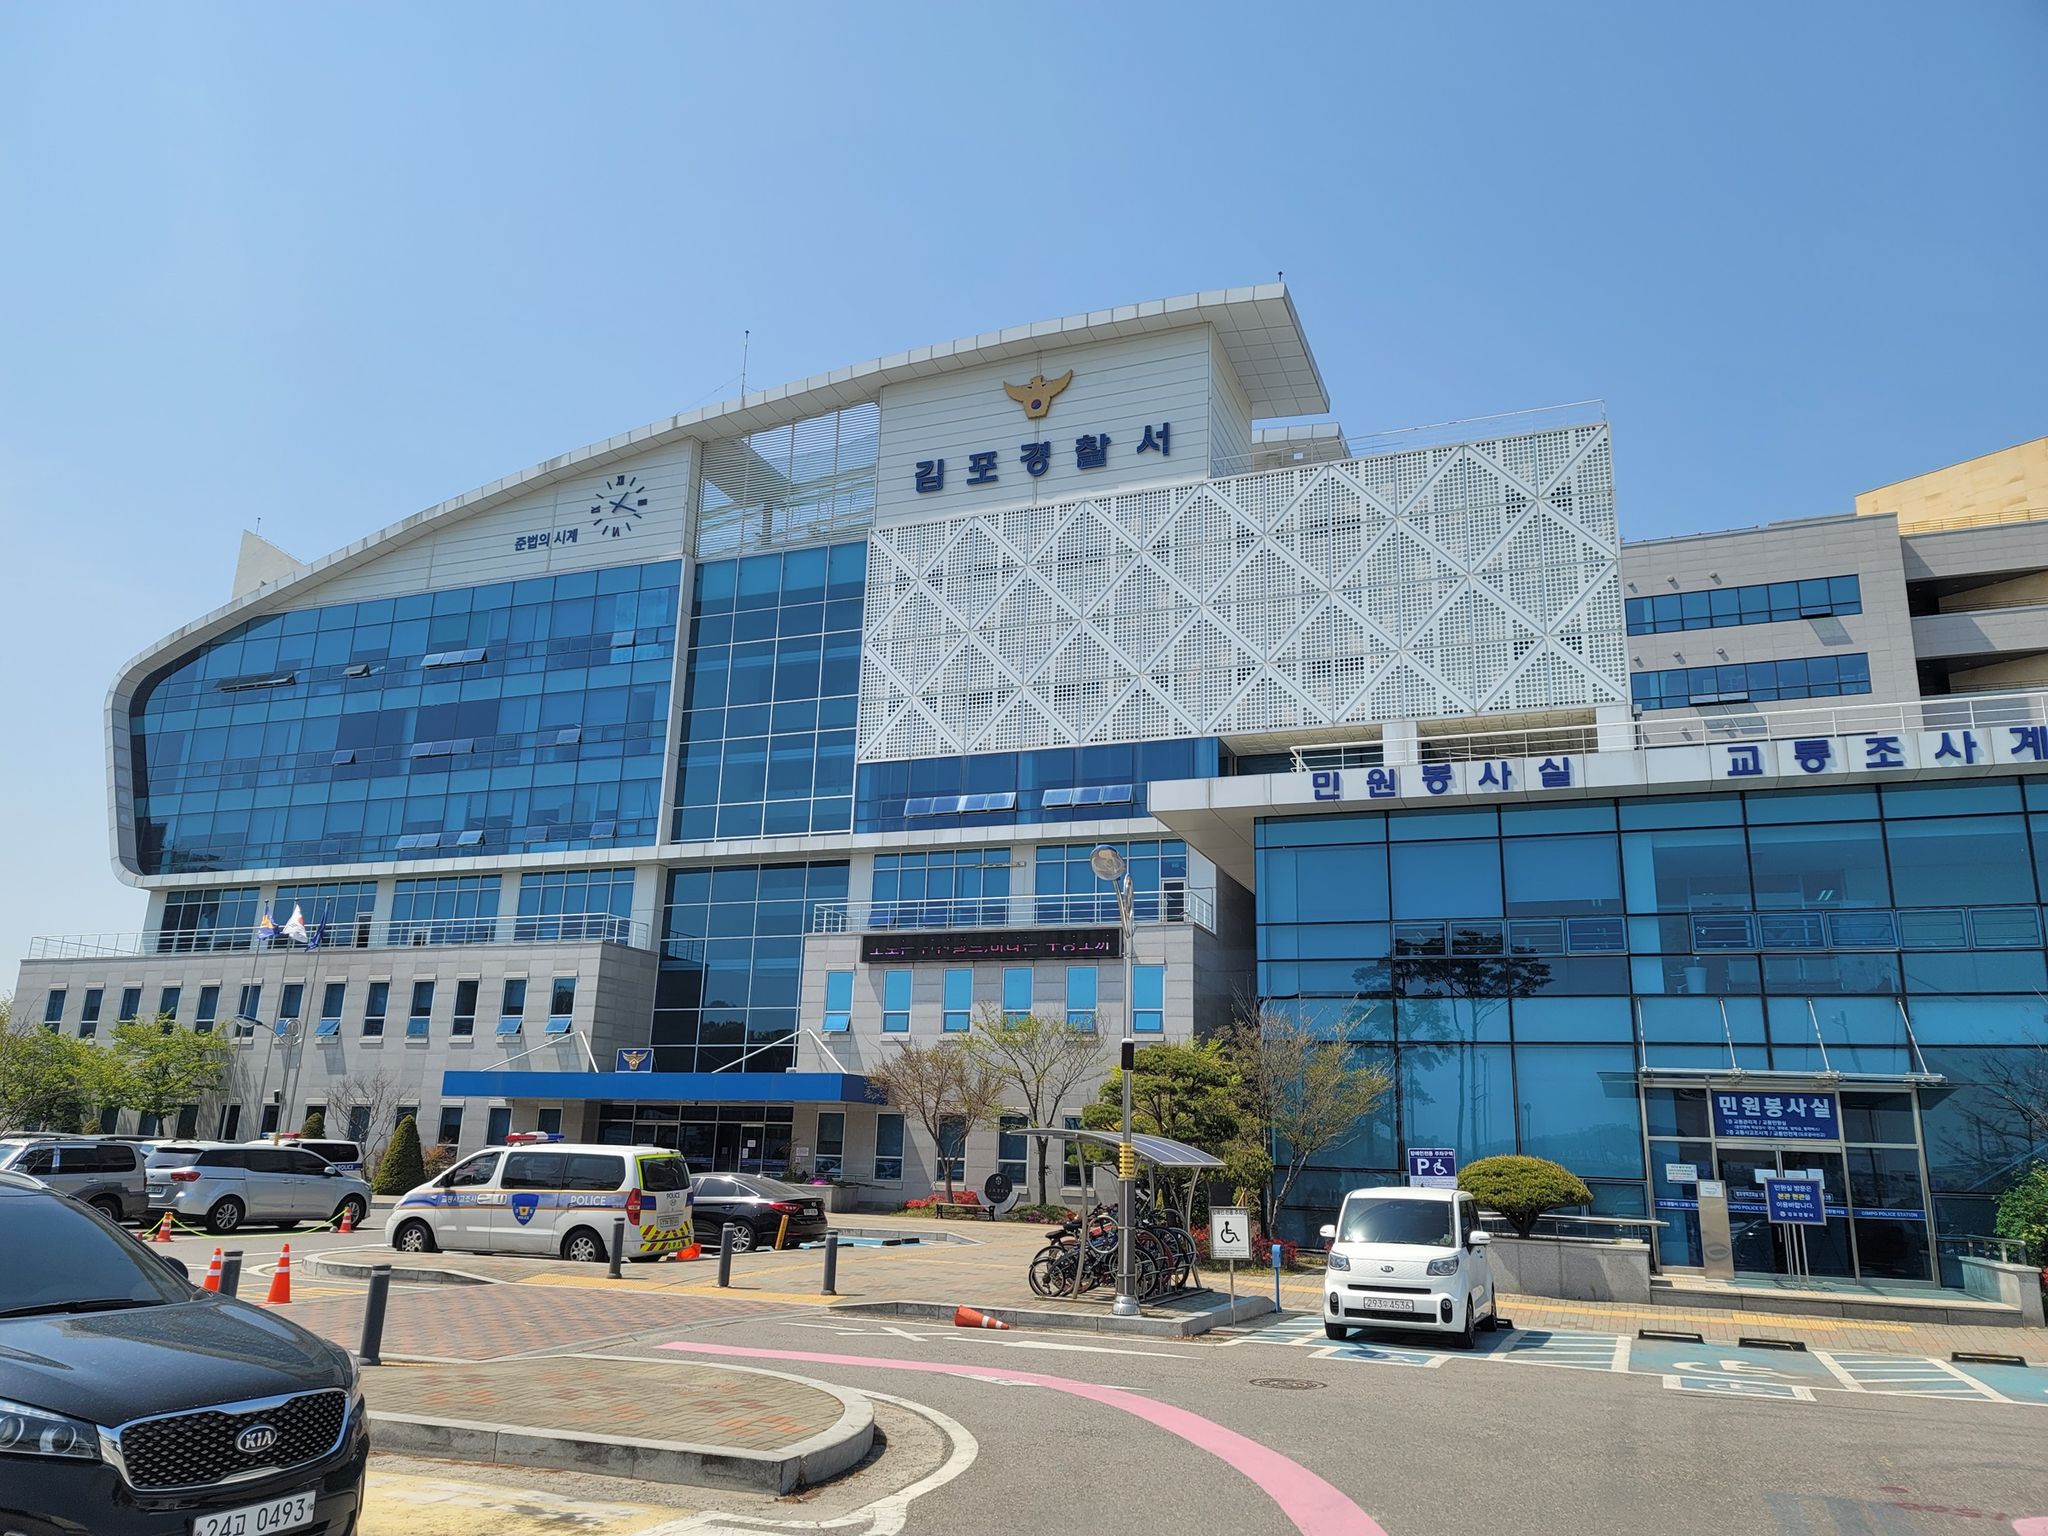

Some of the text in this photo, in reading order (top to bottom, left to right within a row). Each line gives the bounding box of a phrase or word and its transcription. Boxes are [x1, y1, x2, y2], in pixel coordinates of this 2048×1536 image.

[915, 422, 1170, 493] 김포경찰서
[515, 528, 578, 551] 준법의 시계
[1727, 726, 2048, 776] 교통조사계
[1312, 757, 1571, 800] 민원봉사실
[1718, 1096, 1831, 1118] 민원봉사실
[1417, 1158, 1430, 1175] P
[570, 1195, 607, 1206] POLICE
[245, 1430, 272, 1449] KIA
[257, 1498, 306, 1532] 0493
